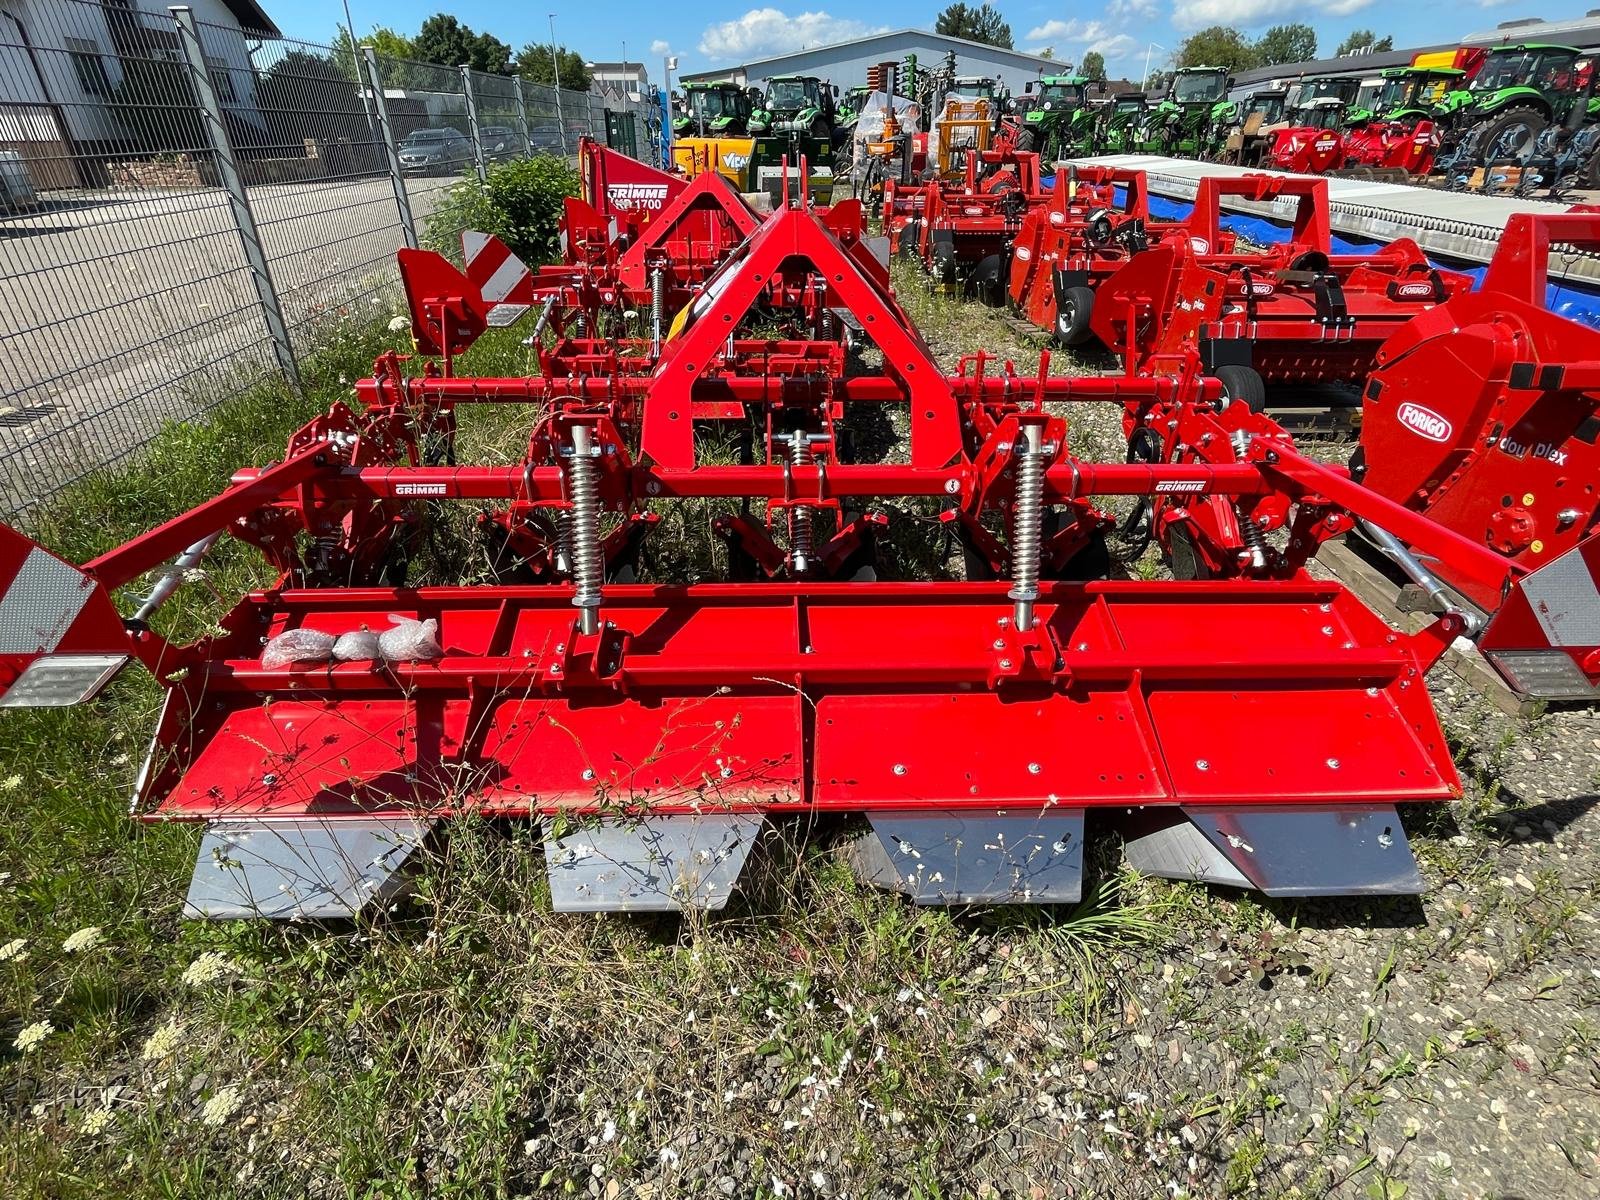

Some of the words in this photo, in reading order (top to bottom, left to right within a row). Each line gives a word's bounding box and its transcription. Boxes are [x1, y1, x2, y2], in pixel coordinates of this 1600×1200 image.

[607, 184, 668, 199] GRIMME
[635, 199, 662, 210] 1700
[1402, 286, 1429, 295] FORIGO
[1402, 405, 1446, 438] FORIGO
[395, 484, 446, 495] GRIMME
[1155, 480, 1206, 491] GRIMME
